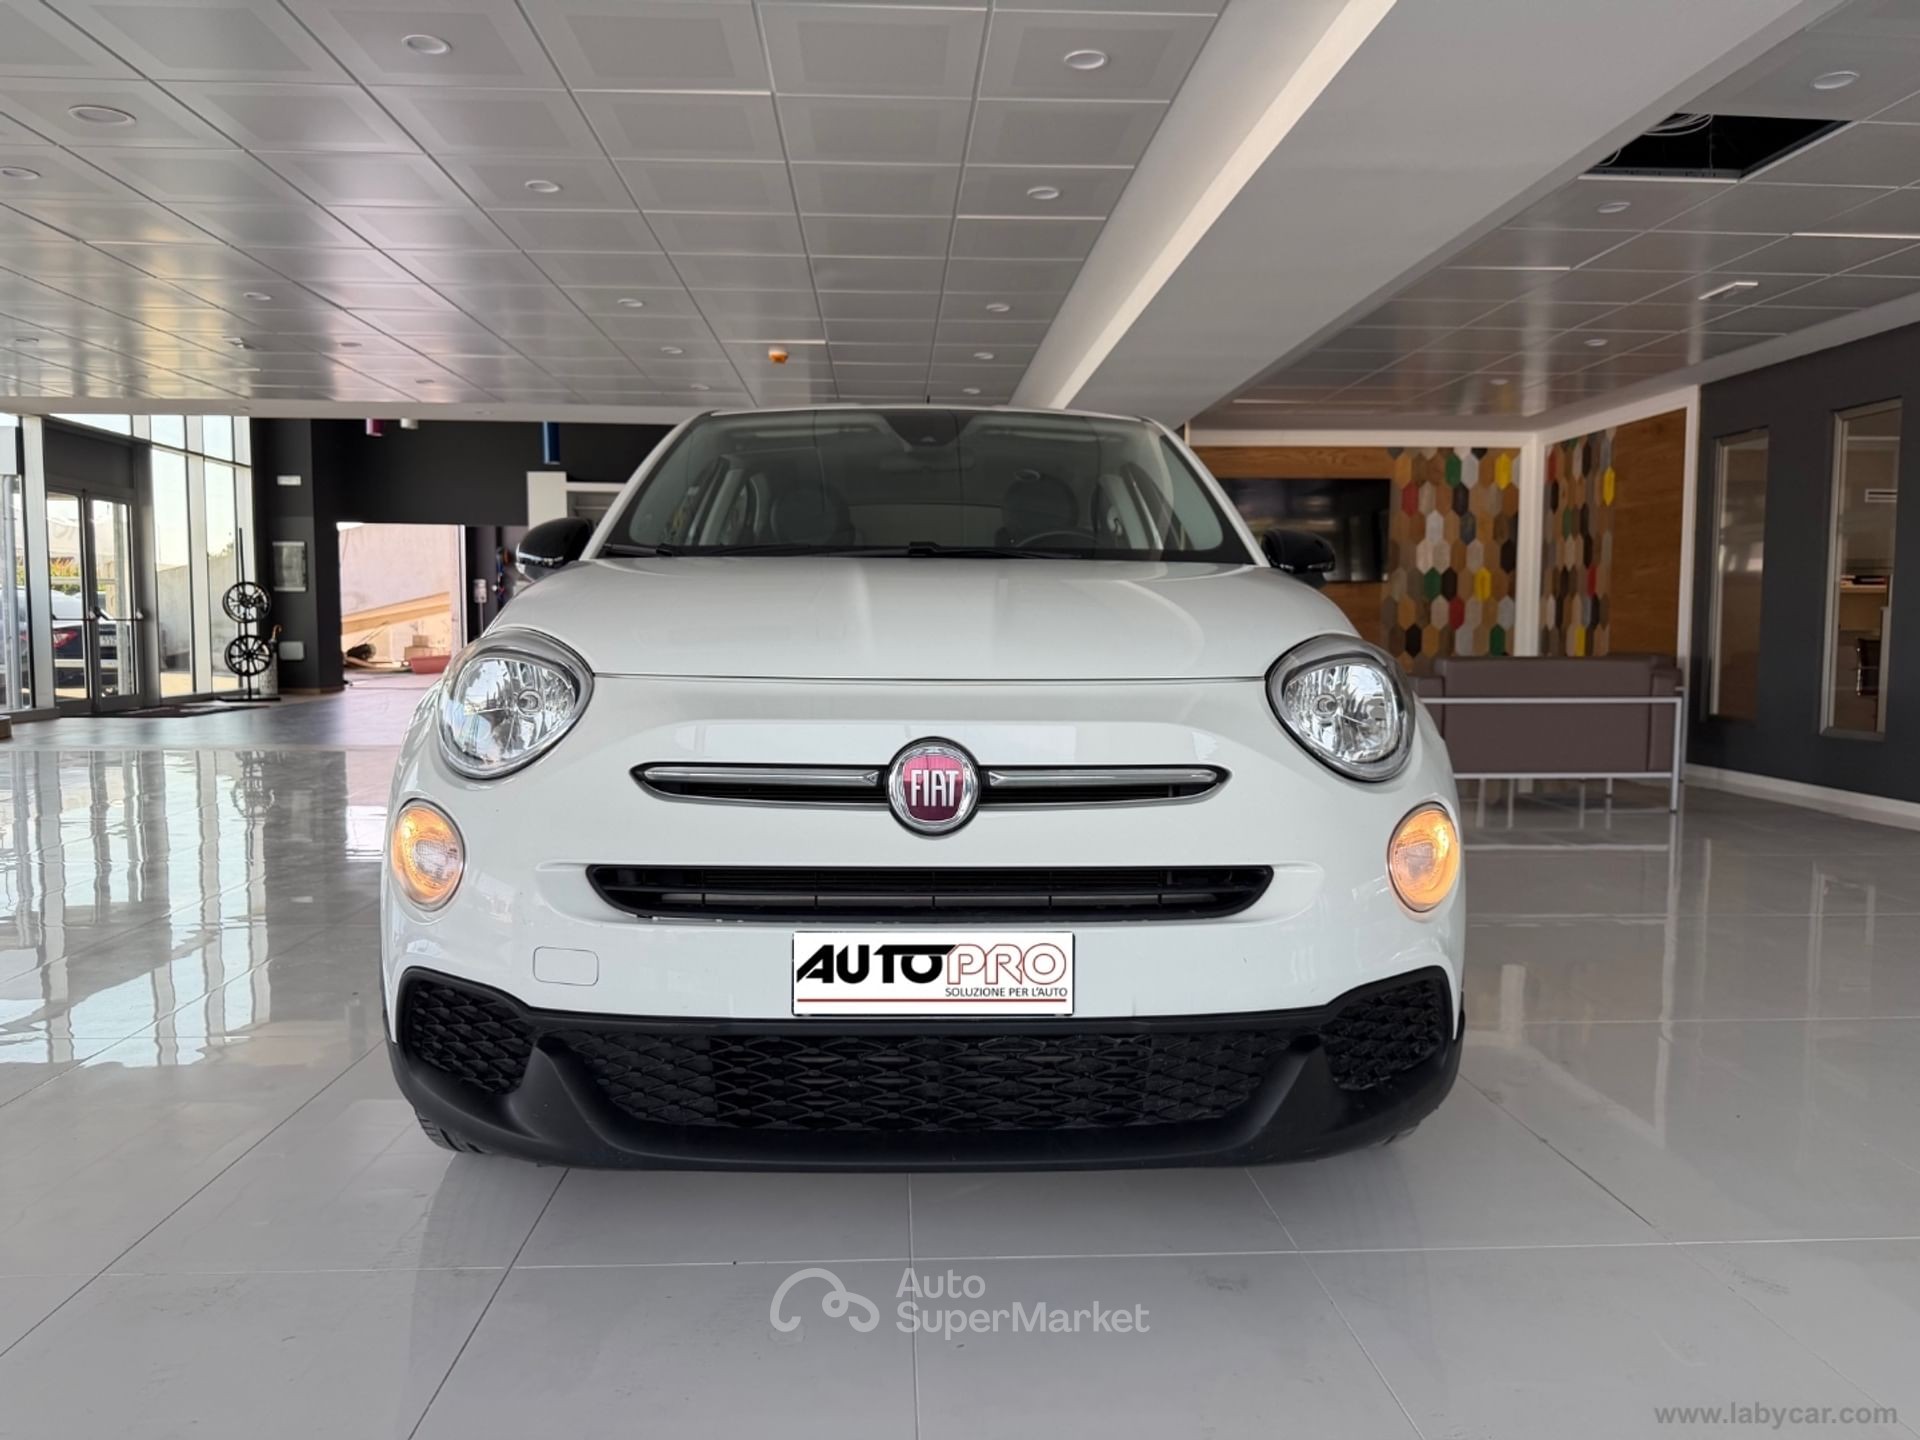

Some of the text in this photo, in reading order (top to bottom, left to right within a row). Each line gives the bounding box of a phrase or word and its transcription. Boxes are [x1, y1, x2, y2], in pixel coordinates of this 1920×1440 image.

[911, 769, 960, 807] FIAT
[945, 987, 1068, 998] SOLUZIONE PER L'AUTO
